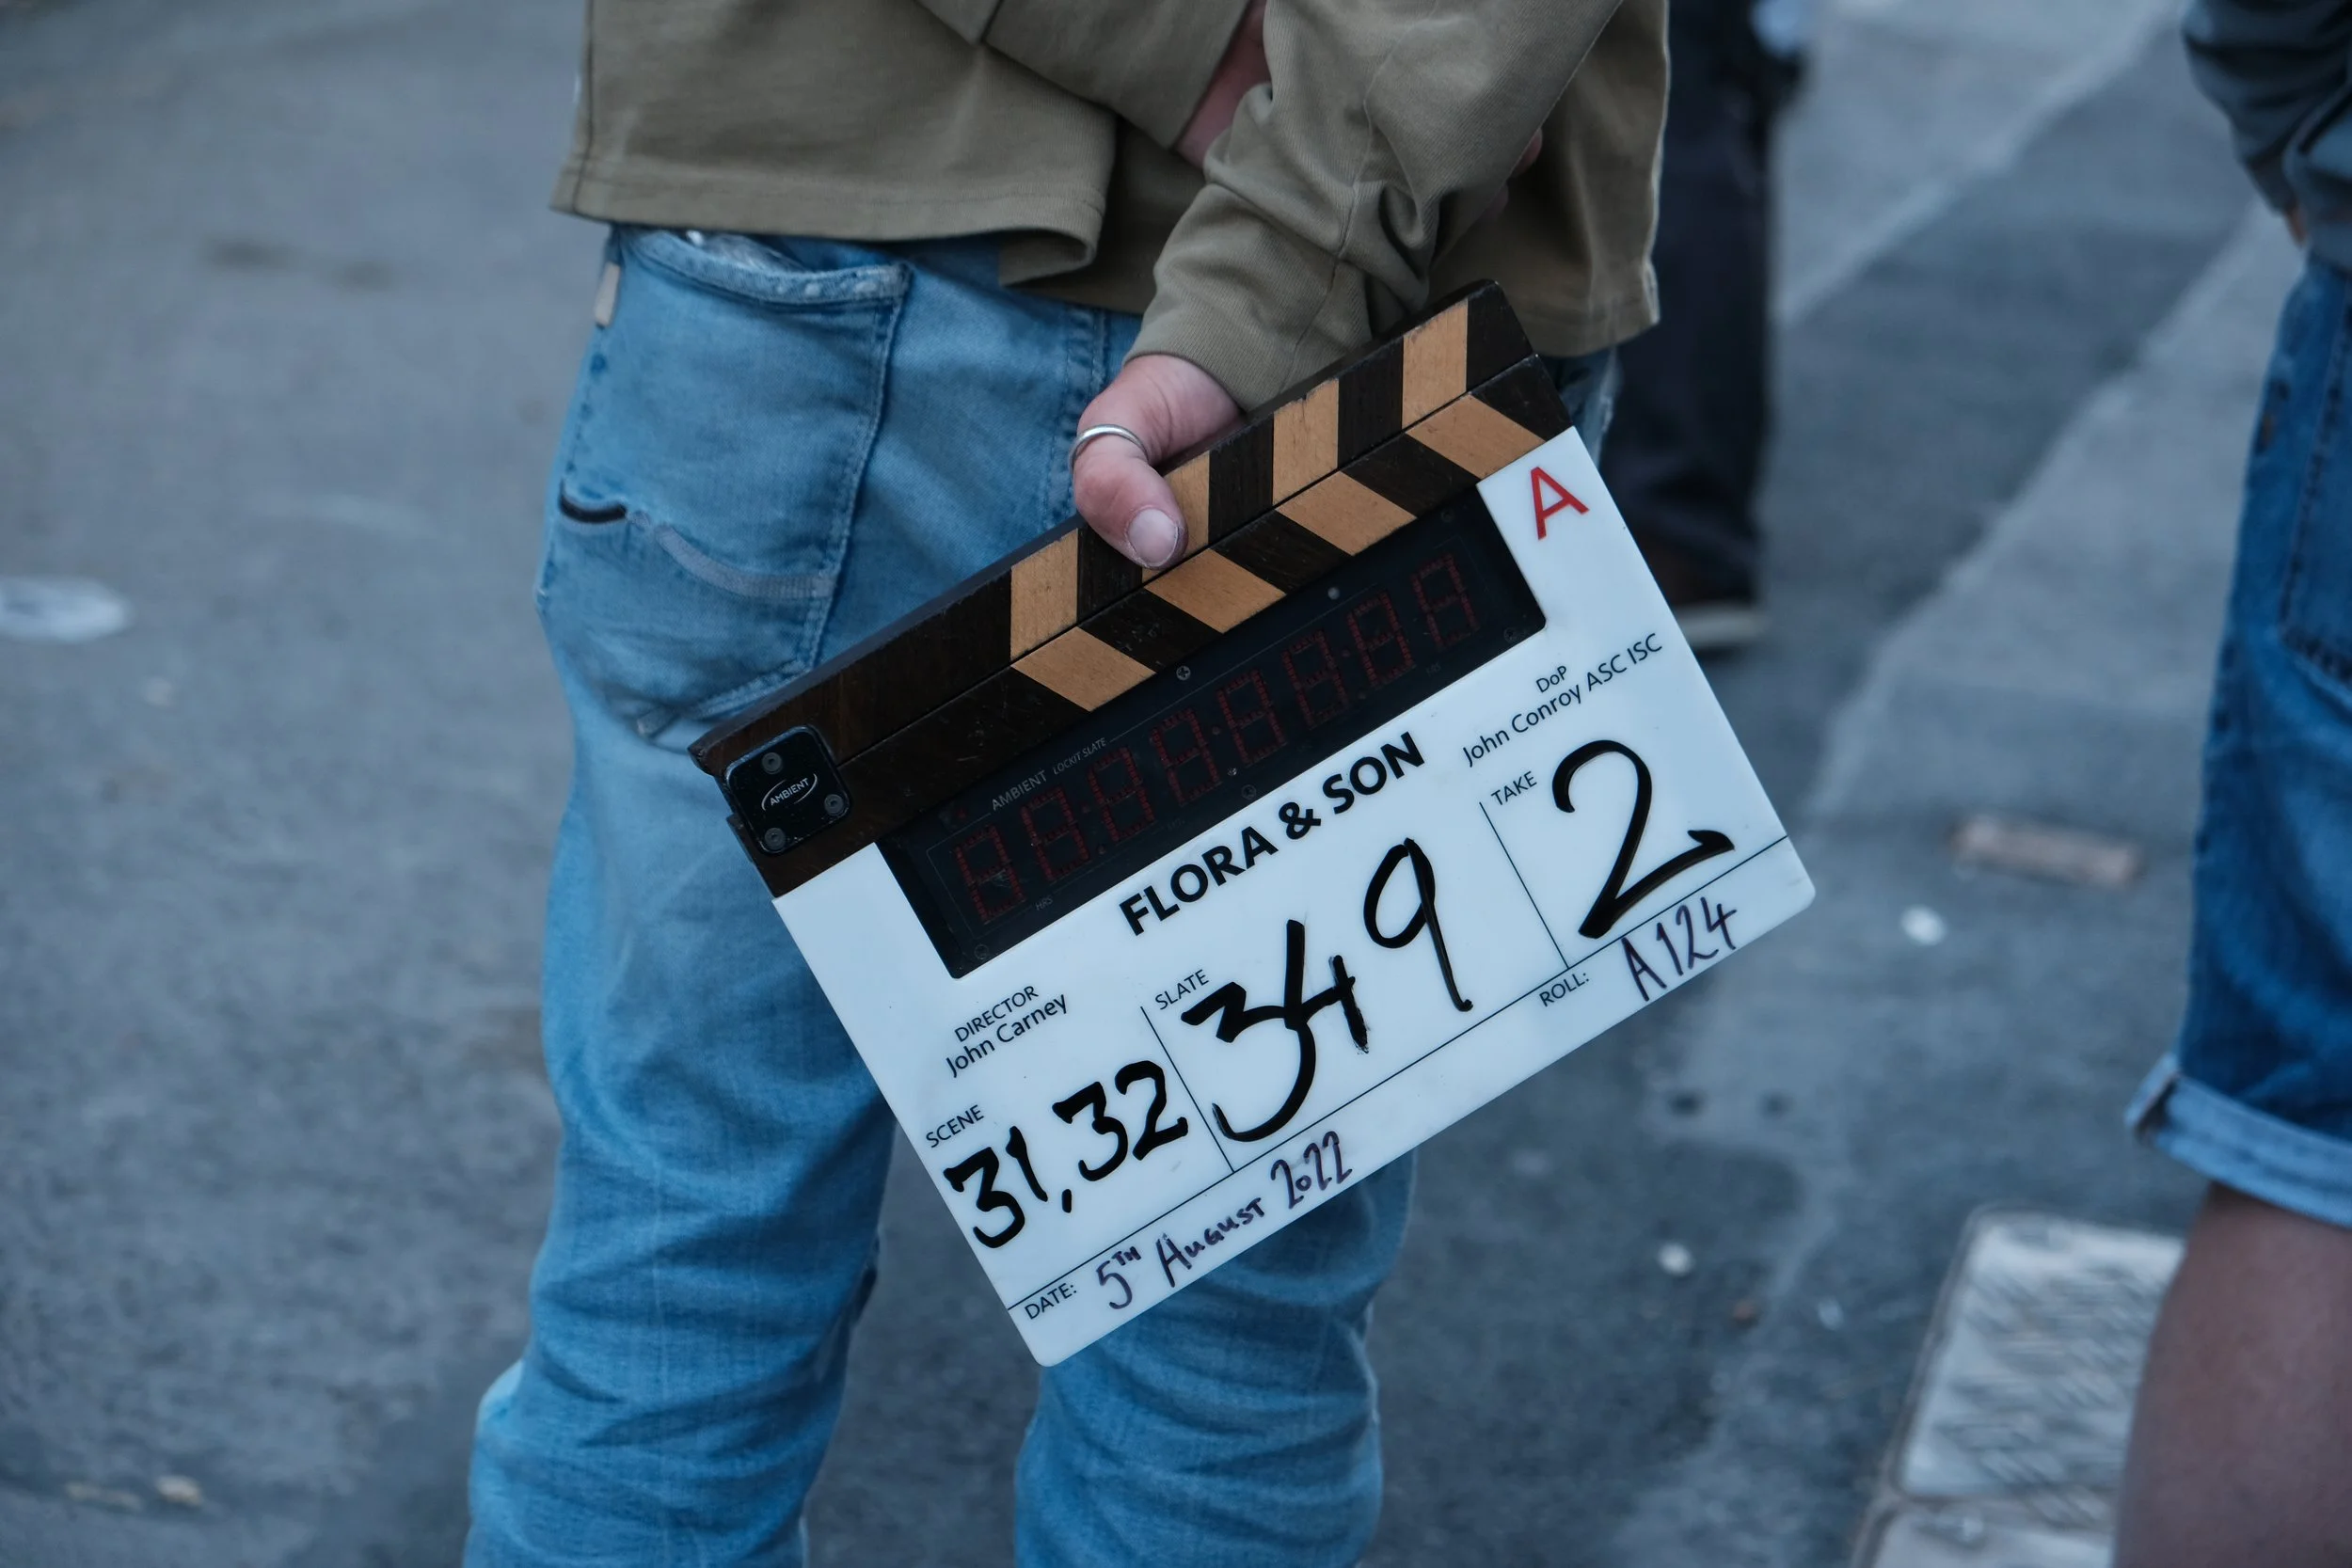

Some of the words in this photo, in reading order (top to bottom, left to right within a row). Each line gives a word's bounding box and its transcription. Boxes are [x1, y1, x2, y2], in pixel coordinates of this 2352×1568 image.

[1530, 466, 1590, 541] A
[1462, 730, 1511, 768] John
[1511, 684, 1582, 736] Conroy
[1587, 654, 1628, 692] ASC
[1628, 632, 1663, 665] ISC
[1535, 664, 1568, 694] DoP
[769, 777, 810, 806] AMBIENT
[992, 769, 1047, 811] AMBIENT
[1053, 752, 1081, 775] LOCKIT
[1082, 737, 1106, 758] SLATE
[1490, 770, 1537, 807] TAKE
[1118, 825, 1279, 937] FLORA
[1278, 801, 1322, 841] &
[1322, 731, 1425, 816] SON
[1551, 739, 1736, 940] 2
[1621, 895, 1738, 1002] A124
[954, 985, 1040, 1043] DIRECTOR
[1154, 969, 1210, 1011] SLATE
[1180, 837, 1474, 1144] 349
[1538, 973, 1590, 1007] ROLL:
[945, 1038, 996, 1079] John
[995, 994, 1068, 1044] Carney
[925, 1104, 985, 1148] SCENE
[943, 1059, 1189, 1249] 31,32
[1269, 1130, 1354, 1210] 2022
[1024, 1281, 1078, 1321] DATE:
